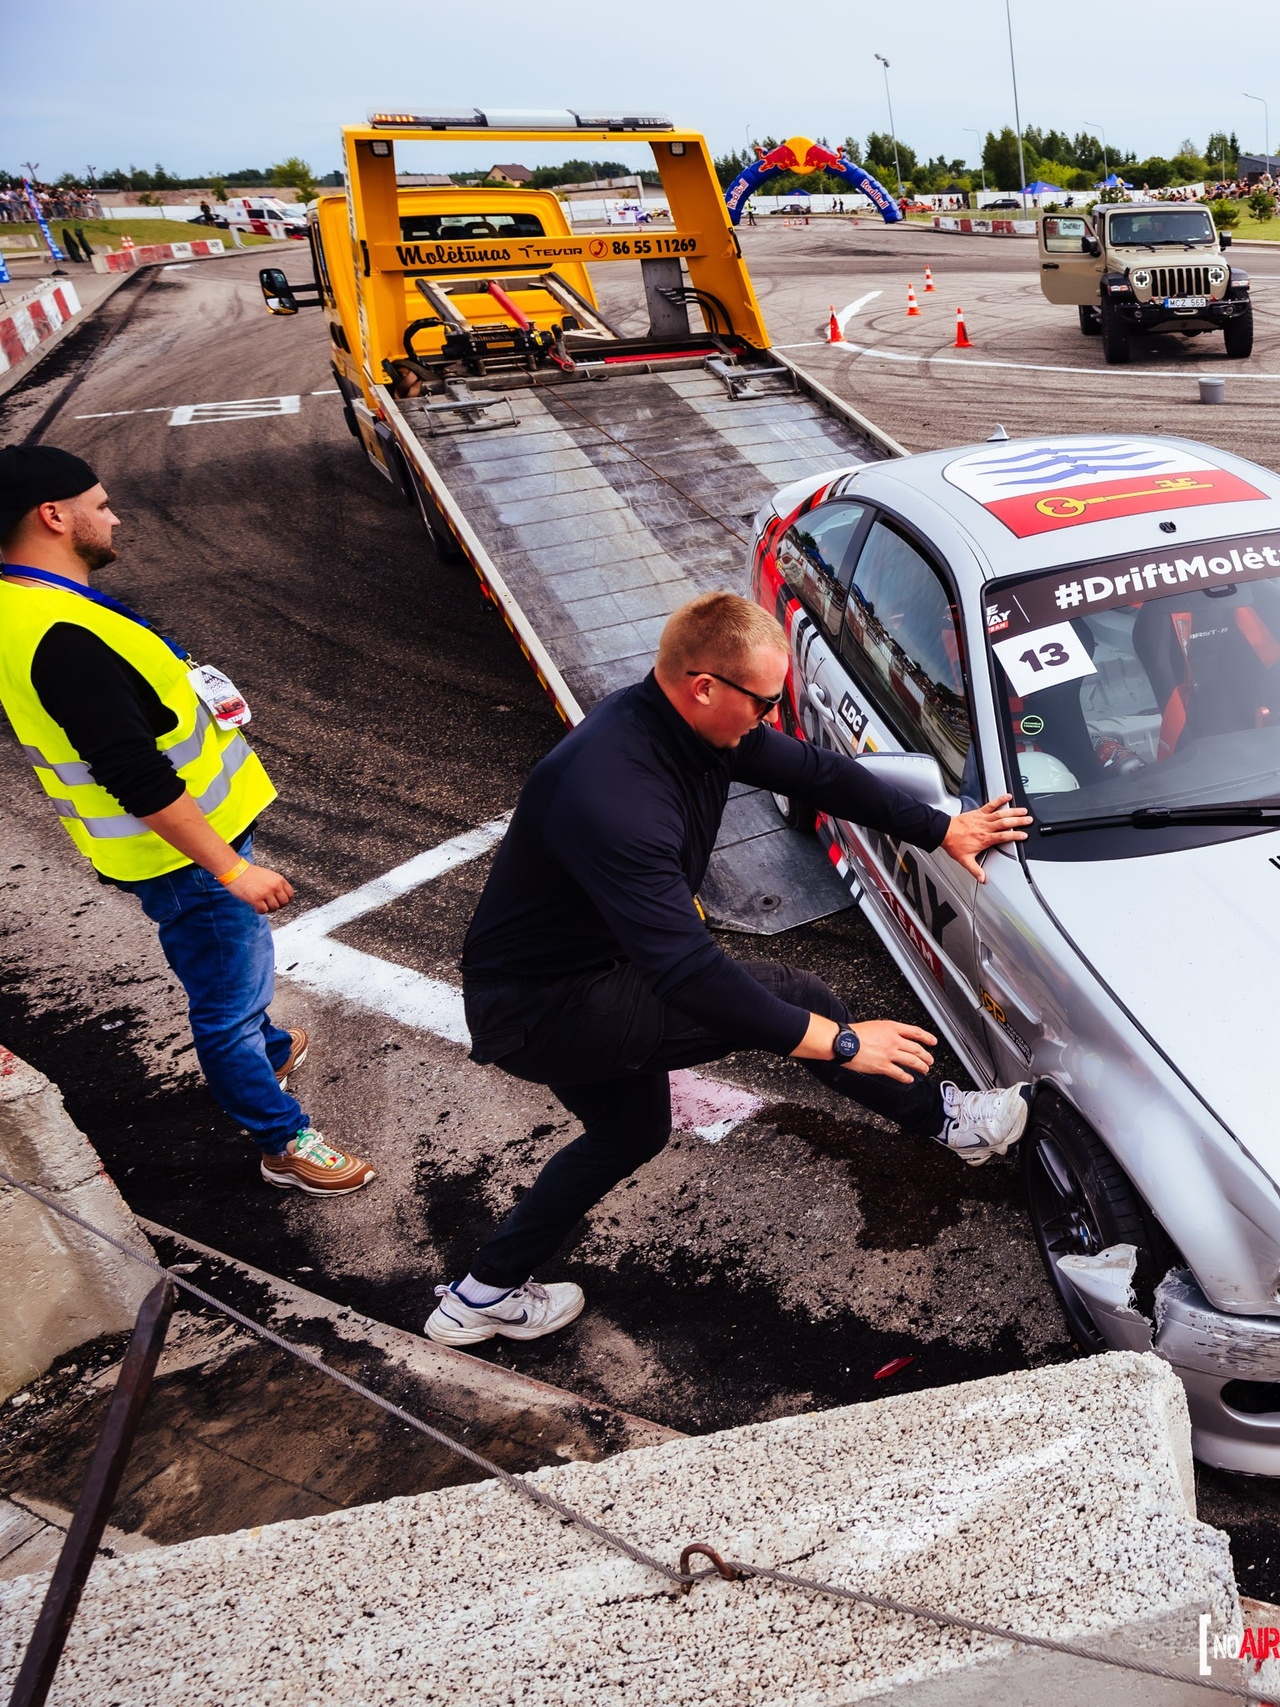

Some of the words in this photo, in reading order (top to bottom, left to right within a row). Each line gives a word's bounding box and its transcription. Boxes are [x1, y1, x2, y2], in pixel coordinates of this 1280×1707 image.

[727, 192, 738, 210] Red
[737, 178, 750, 196] Bull
[861, 179, 875, 195] Red
[873, 192, 889, 209] Bull
[396, 244, 511, 267] Molėtūnas
[612, 241, 630, 255] 86
[634, 240, 651, 254] 55
[656, 238, 697, 253] 11269
[1170, 299, 1186, 307] MCZ
[1190, 299, 1205, 307] 565
[1018, 642, 1070, 673] 13
[887, 890, 935, 970] TEAM
